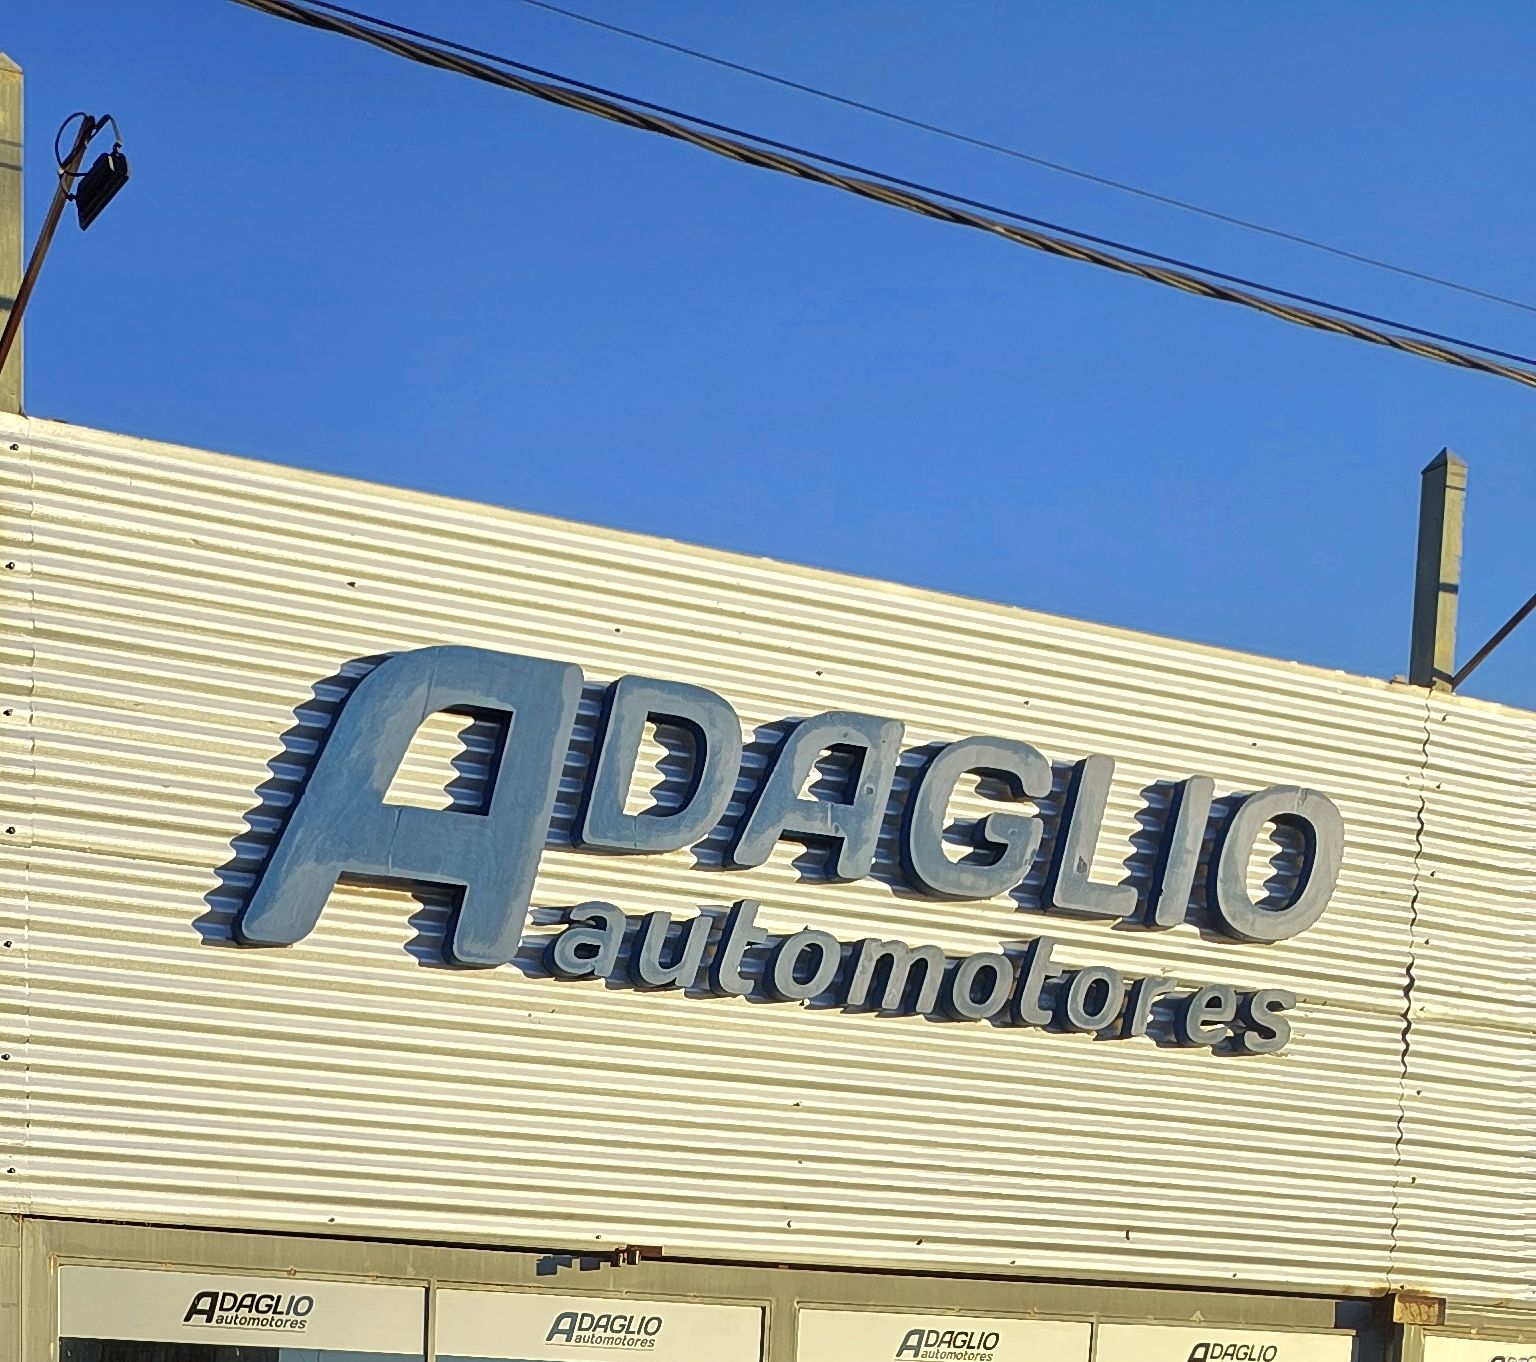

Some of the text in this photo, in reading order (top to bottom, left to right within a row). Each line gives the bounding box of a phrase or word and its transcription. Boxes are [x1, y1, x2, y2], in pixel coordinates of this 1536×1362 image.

[239, 643, 1346, 967] ADAGLIO
[550, 897, 1298, 1056] automotores
[183, 1291, 314, 1323] ADAGLIO
[215, 1314, 307, 1330] automotores
[545, 1312, 663, 1342] ADAGLIO
[574, 1333, 656, 1348] automotores
[895, 1329, 1000, 1358] ADAGLIO
[920, 1349, 994, 1362] automotores
